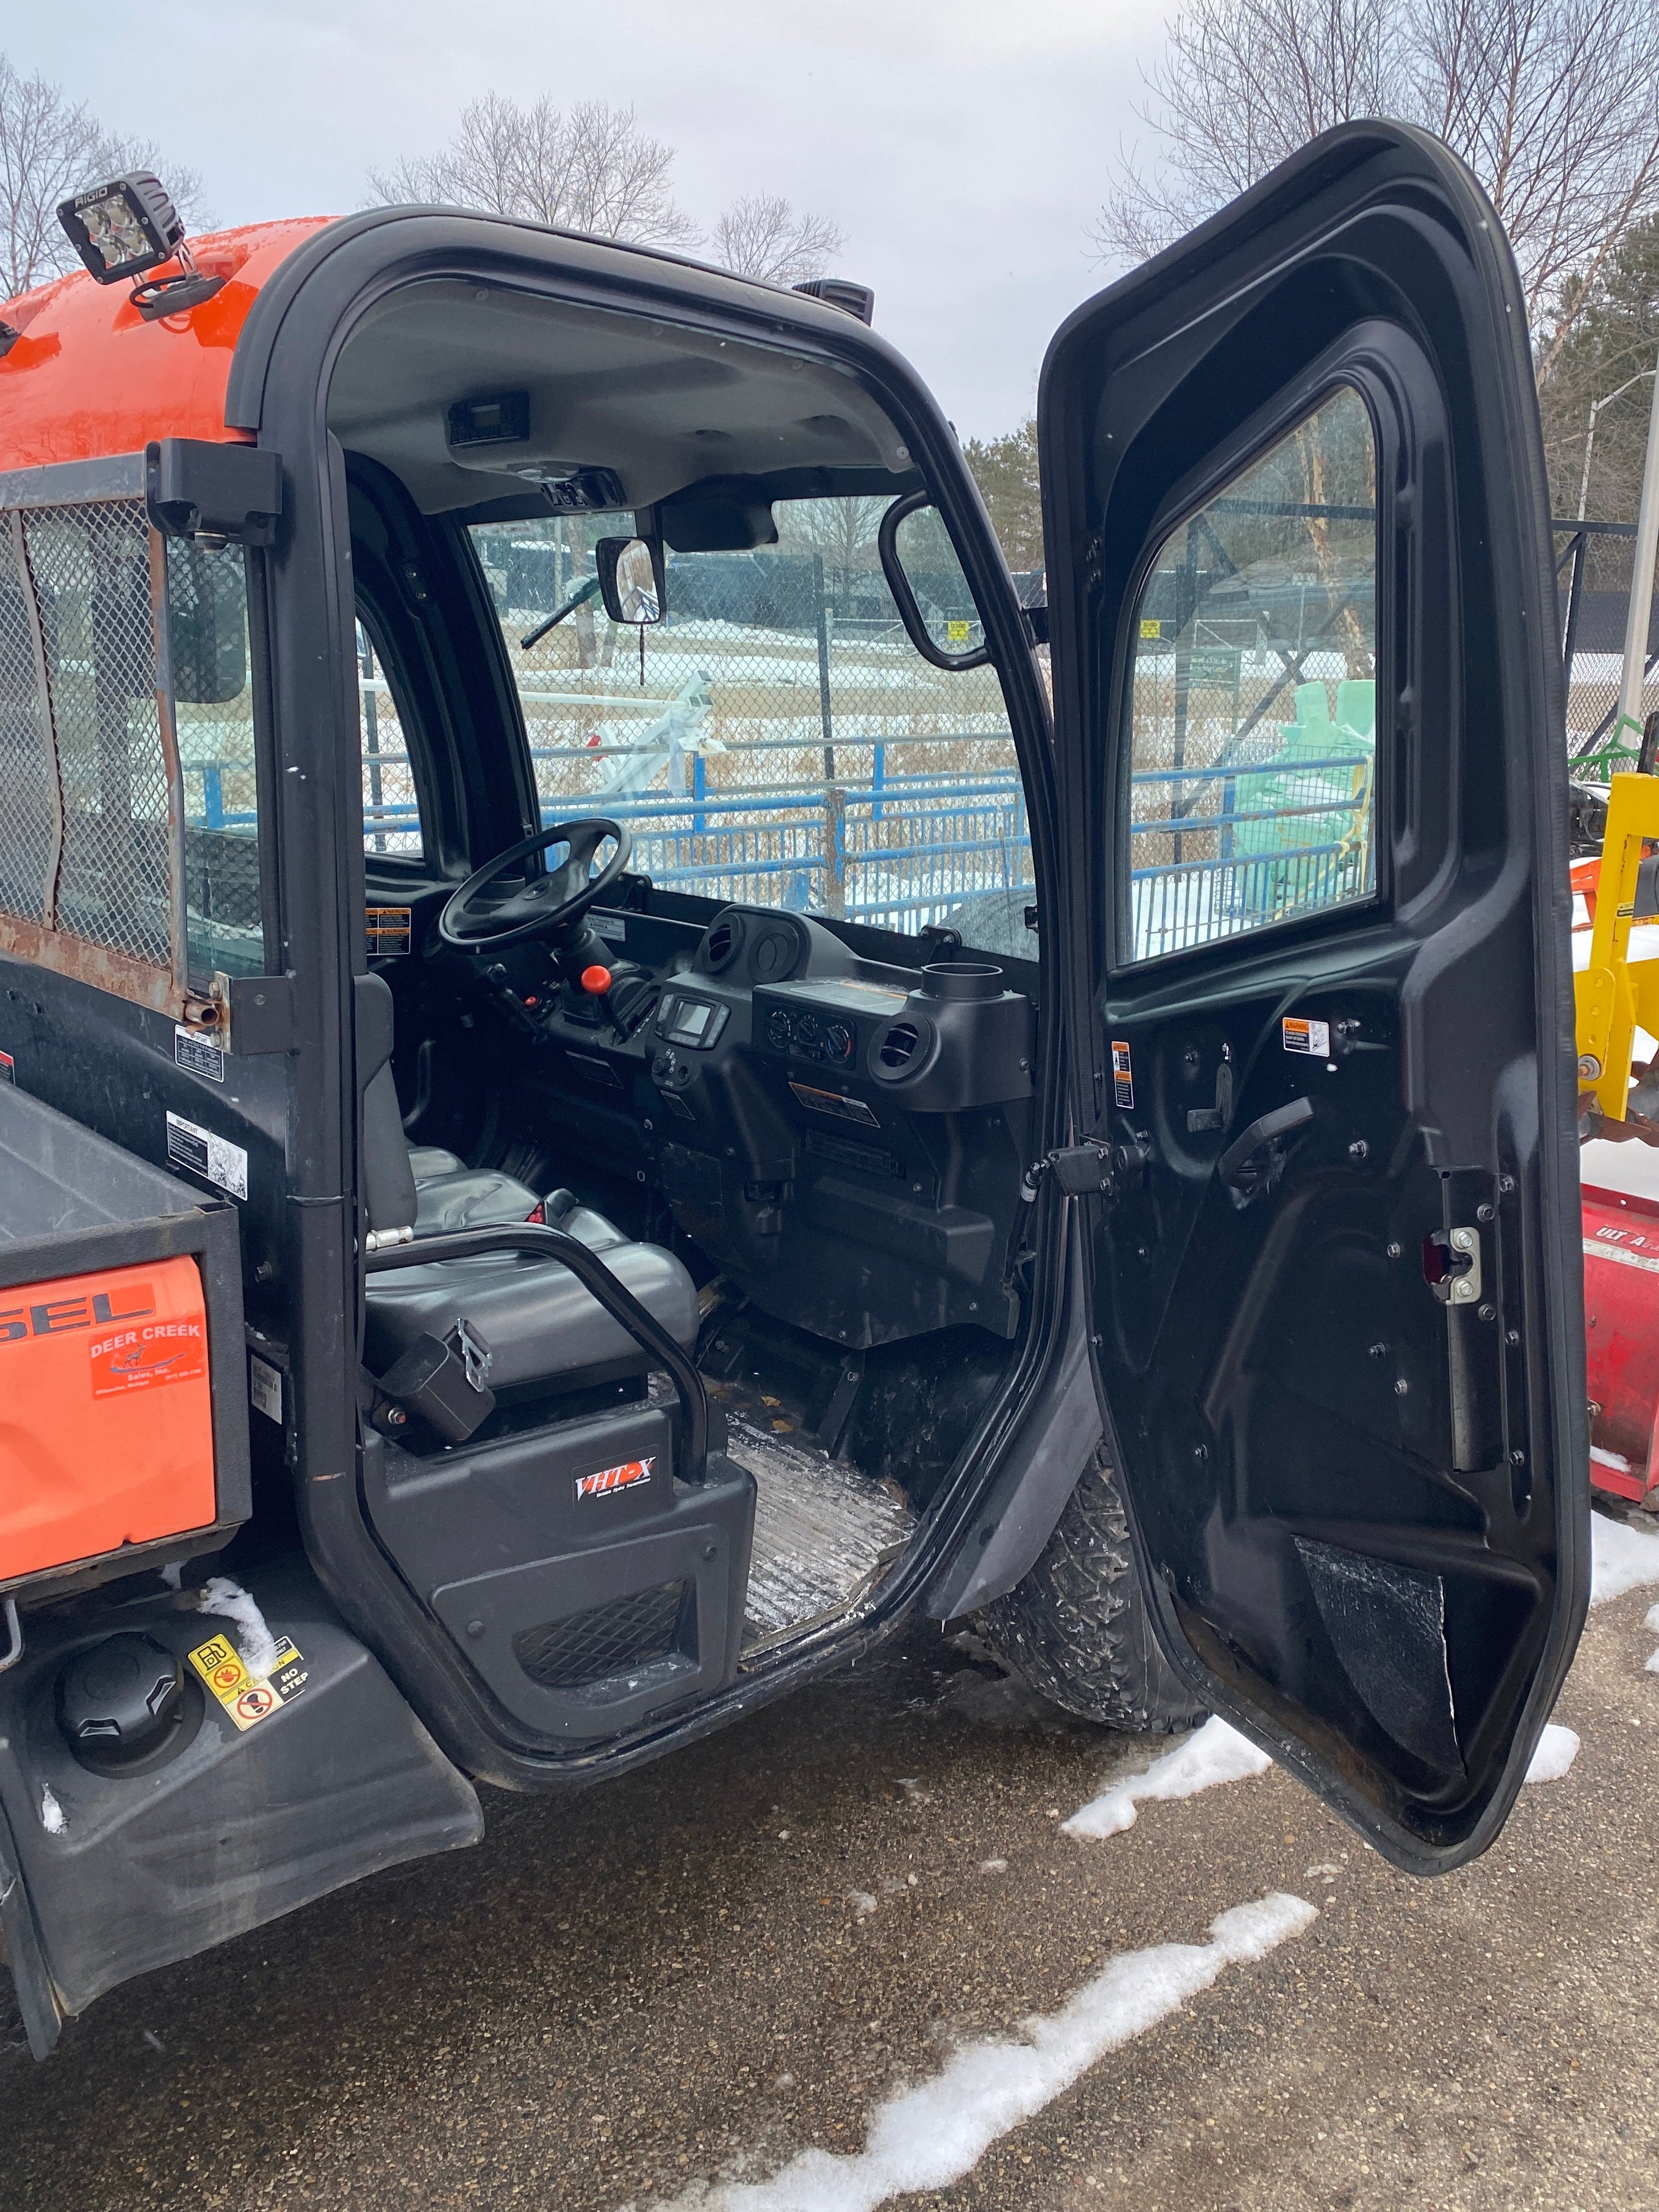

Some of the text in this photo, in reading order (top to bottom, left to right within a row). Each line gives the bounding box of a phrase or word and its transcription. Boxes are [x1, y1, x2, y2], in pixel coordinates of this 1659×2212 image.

[74, 186, 108, 208] RIGID
[176, 1118, 198, 1135] IMPORTANT
[91, 1324, 201, 1359] DEER CREEK
[127, 1372, 153, 1381] Sales,
[280, 1668, 298, 1682] NO
[280, 1672, 309, 1695] STEP
